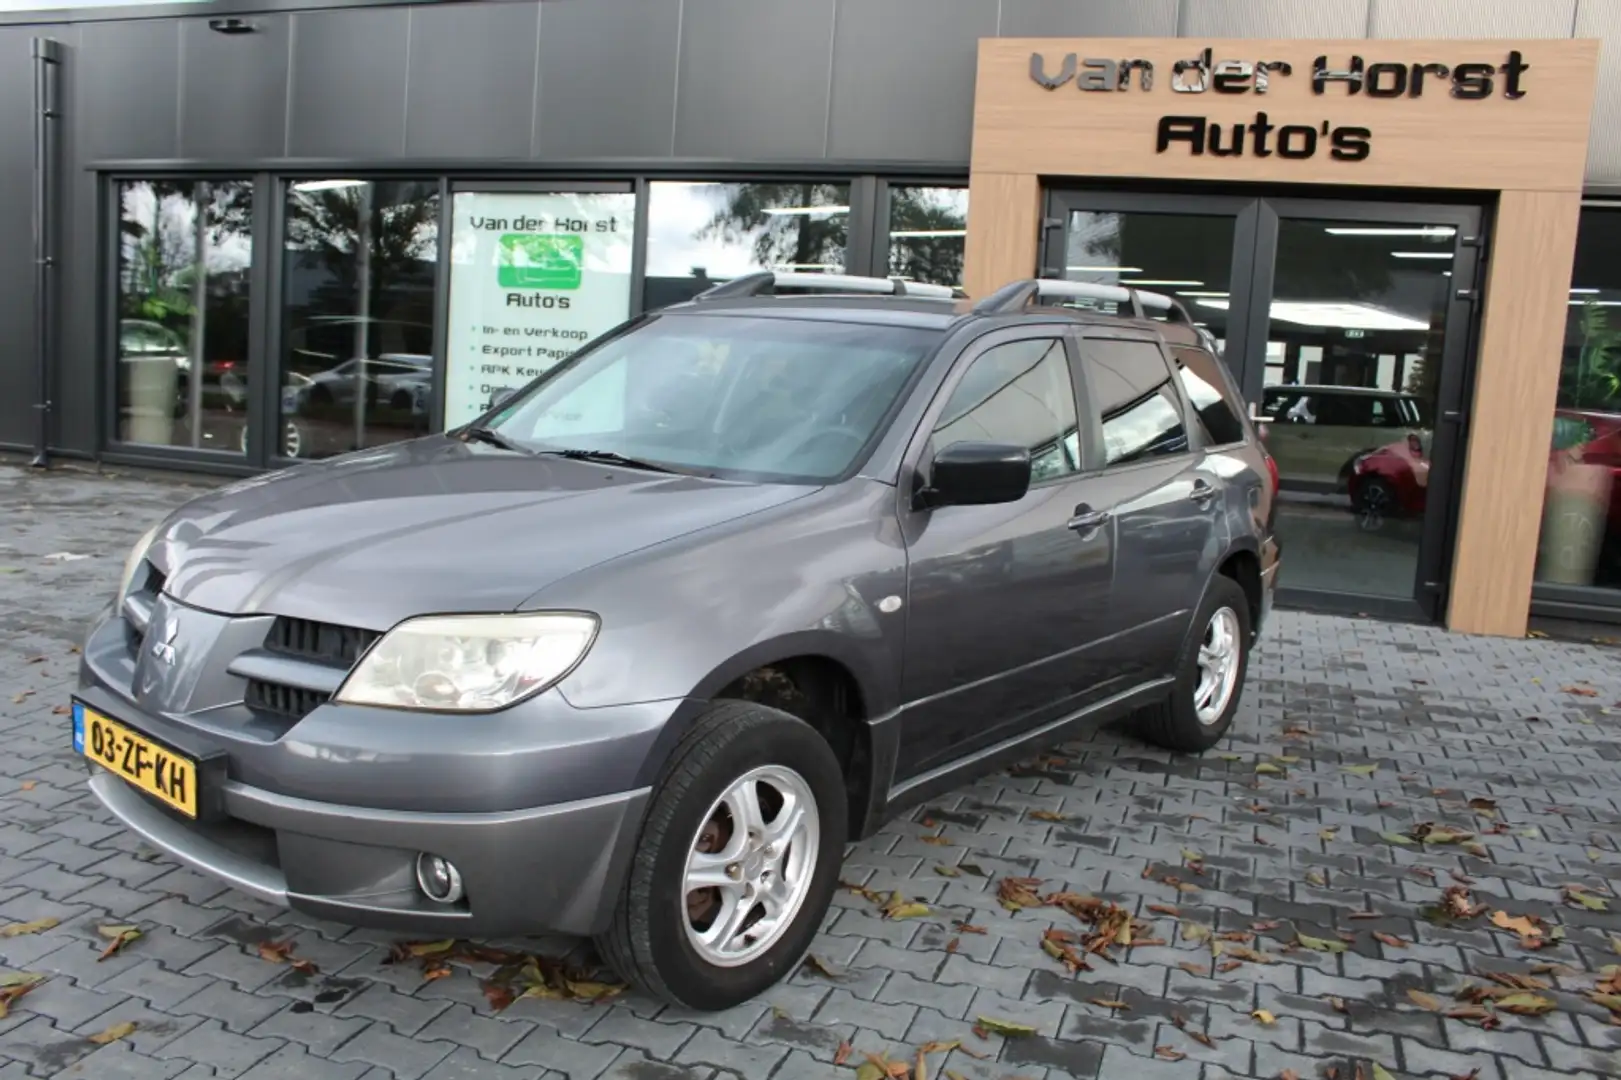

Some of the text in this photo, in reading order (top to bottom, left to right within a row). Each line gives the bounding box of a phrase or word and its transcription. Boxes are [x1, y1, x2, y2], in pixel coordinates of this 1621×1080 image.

[1030, 47, 1530, 100] Van der Horst
[1155, 111, 1372, 162] Auto's
[470, 215, 508, 232] Van
[506, 291, 571, 310] Auto's
[503, 326, 520, 336] en
[524, 327, 589, 341] Verkoop
[481, 344, 532, 358] Export
[91, 720, 186, 804] 03-ZF-KH
